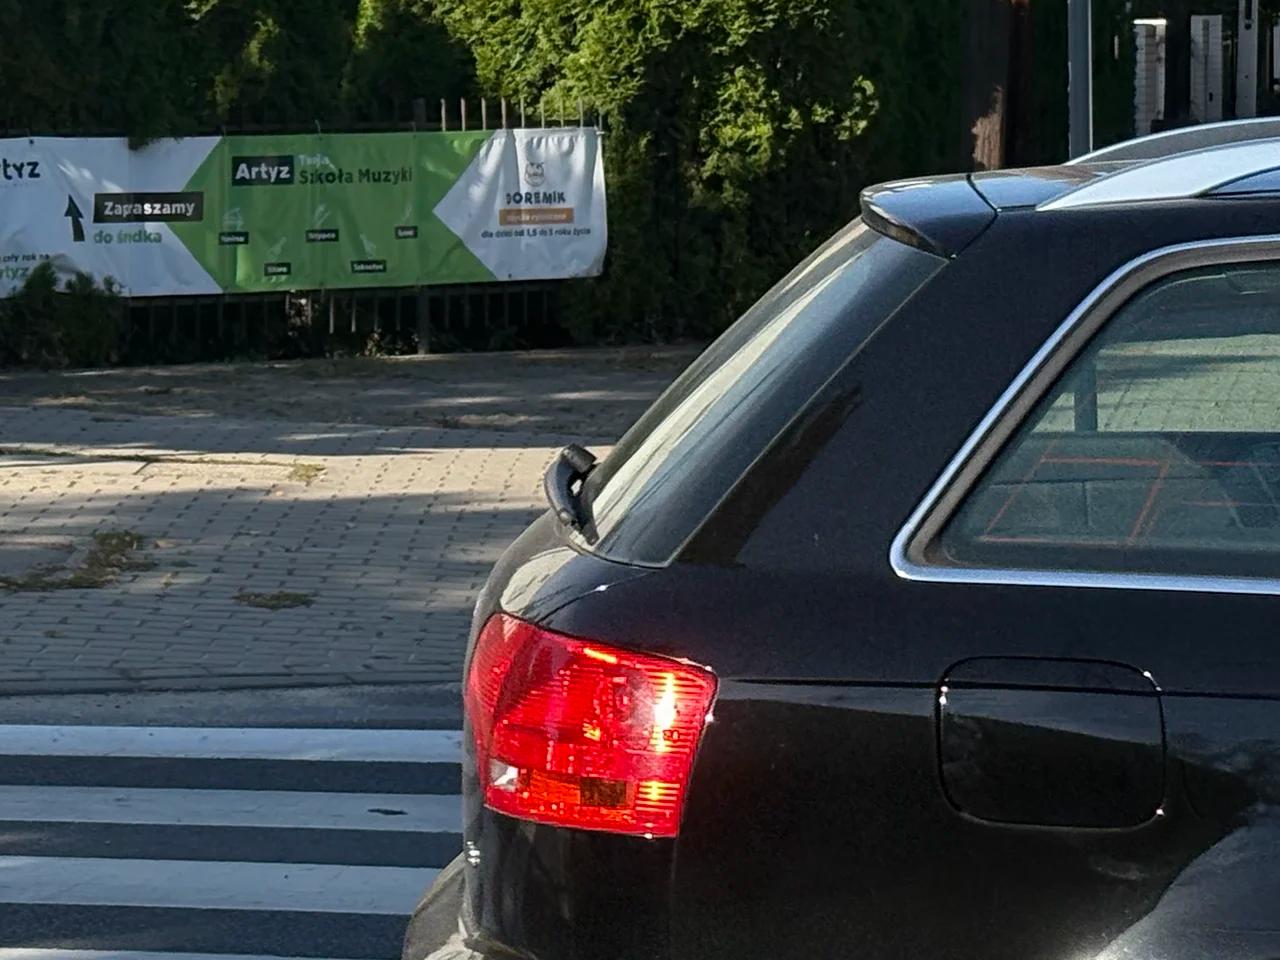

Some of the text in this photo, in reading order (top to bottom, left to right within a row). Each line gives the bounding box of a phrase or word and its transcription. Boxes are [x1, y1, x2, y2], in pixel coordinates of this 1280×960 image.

[235, 163, 291, 183] Artyz
[358, 167, 413, 185] Muzyki
[93, 228, 114, 244] do
